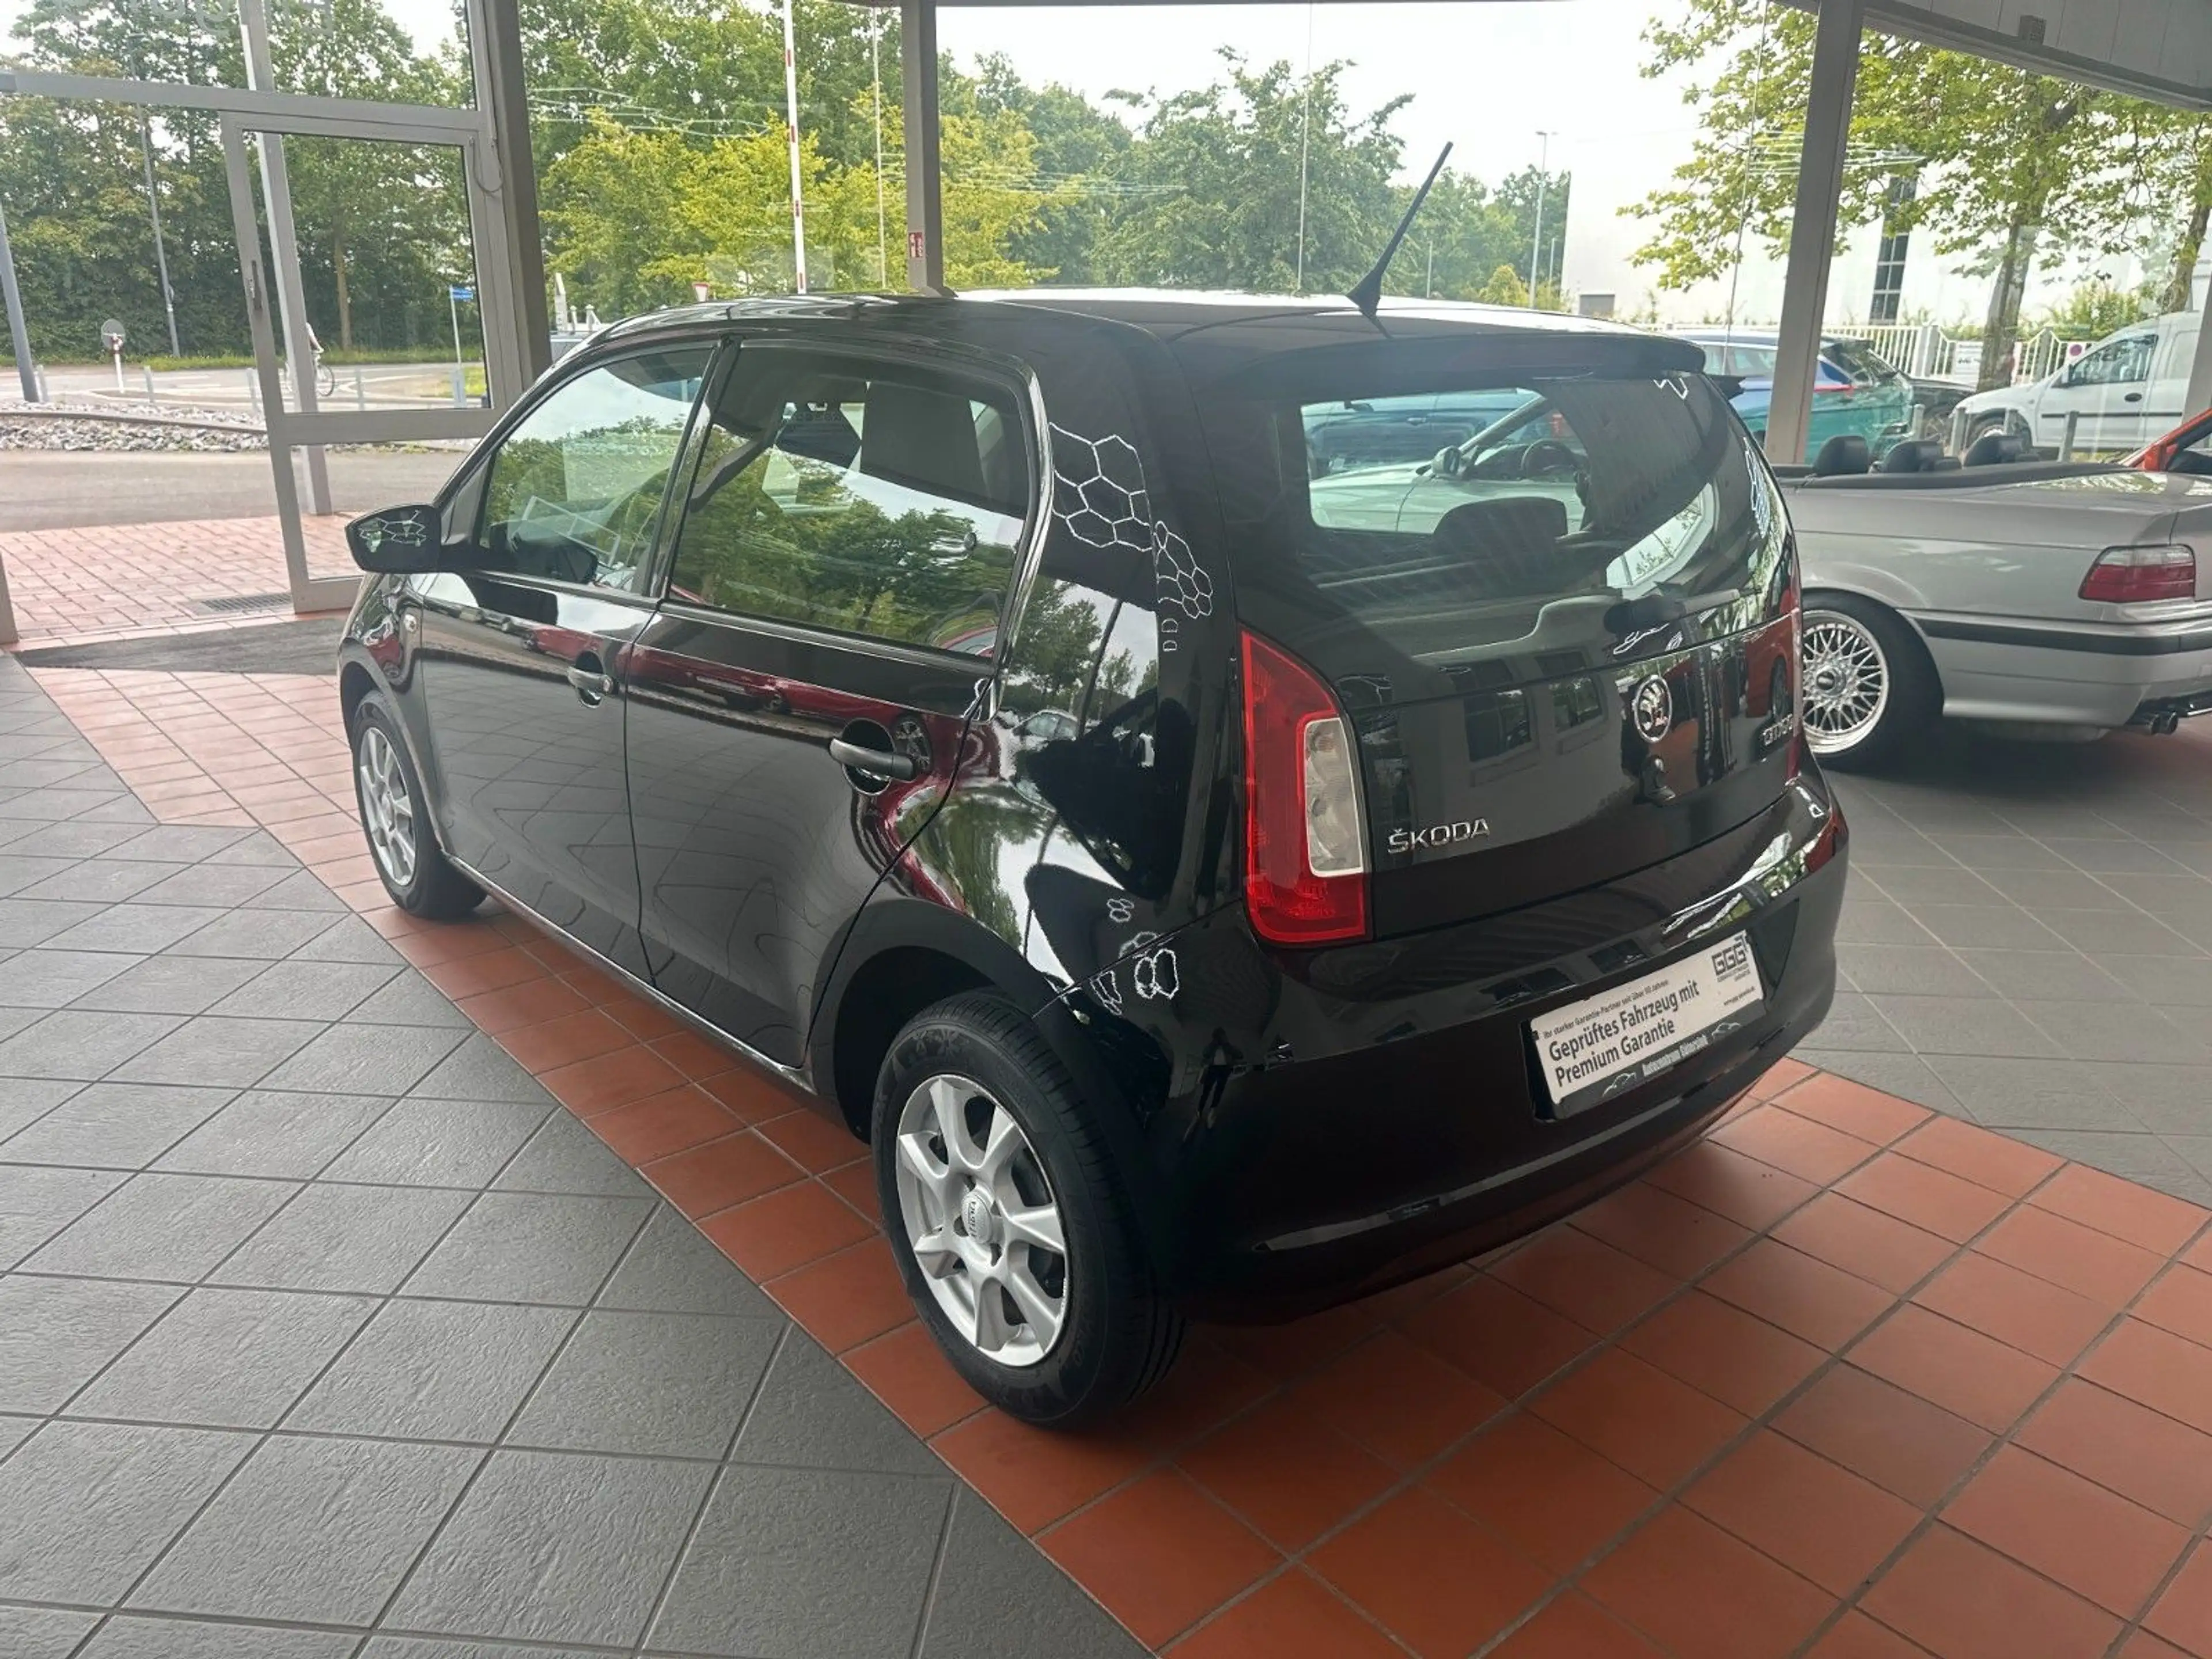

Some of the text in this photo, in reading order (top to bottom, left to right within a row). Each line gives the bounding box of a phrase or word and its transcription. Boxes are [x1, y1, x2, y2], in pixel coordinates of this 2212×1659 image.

[1387, 818, 1490, 854] ŠKODA
[1548, 1019, 1620, 1062] Geprüftes
[1619, 992, 1679, 1031] Fahrzeug
[1679, 979, 1700, 1003] mit
[1555, 1046, 1620, 1088] Premium
[1620, 1018, 1675, 1056] Garantie
